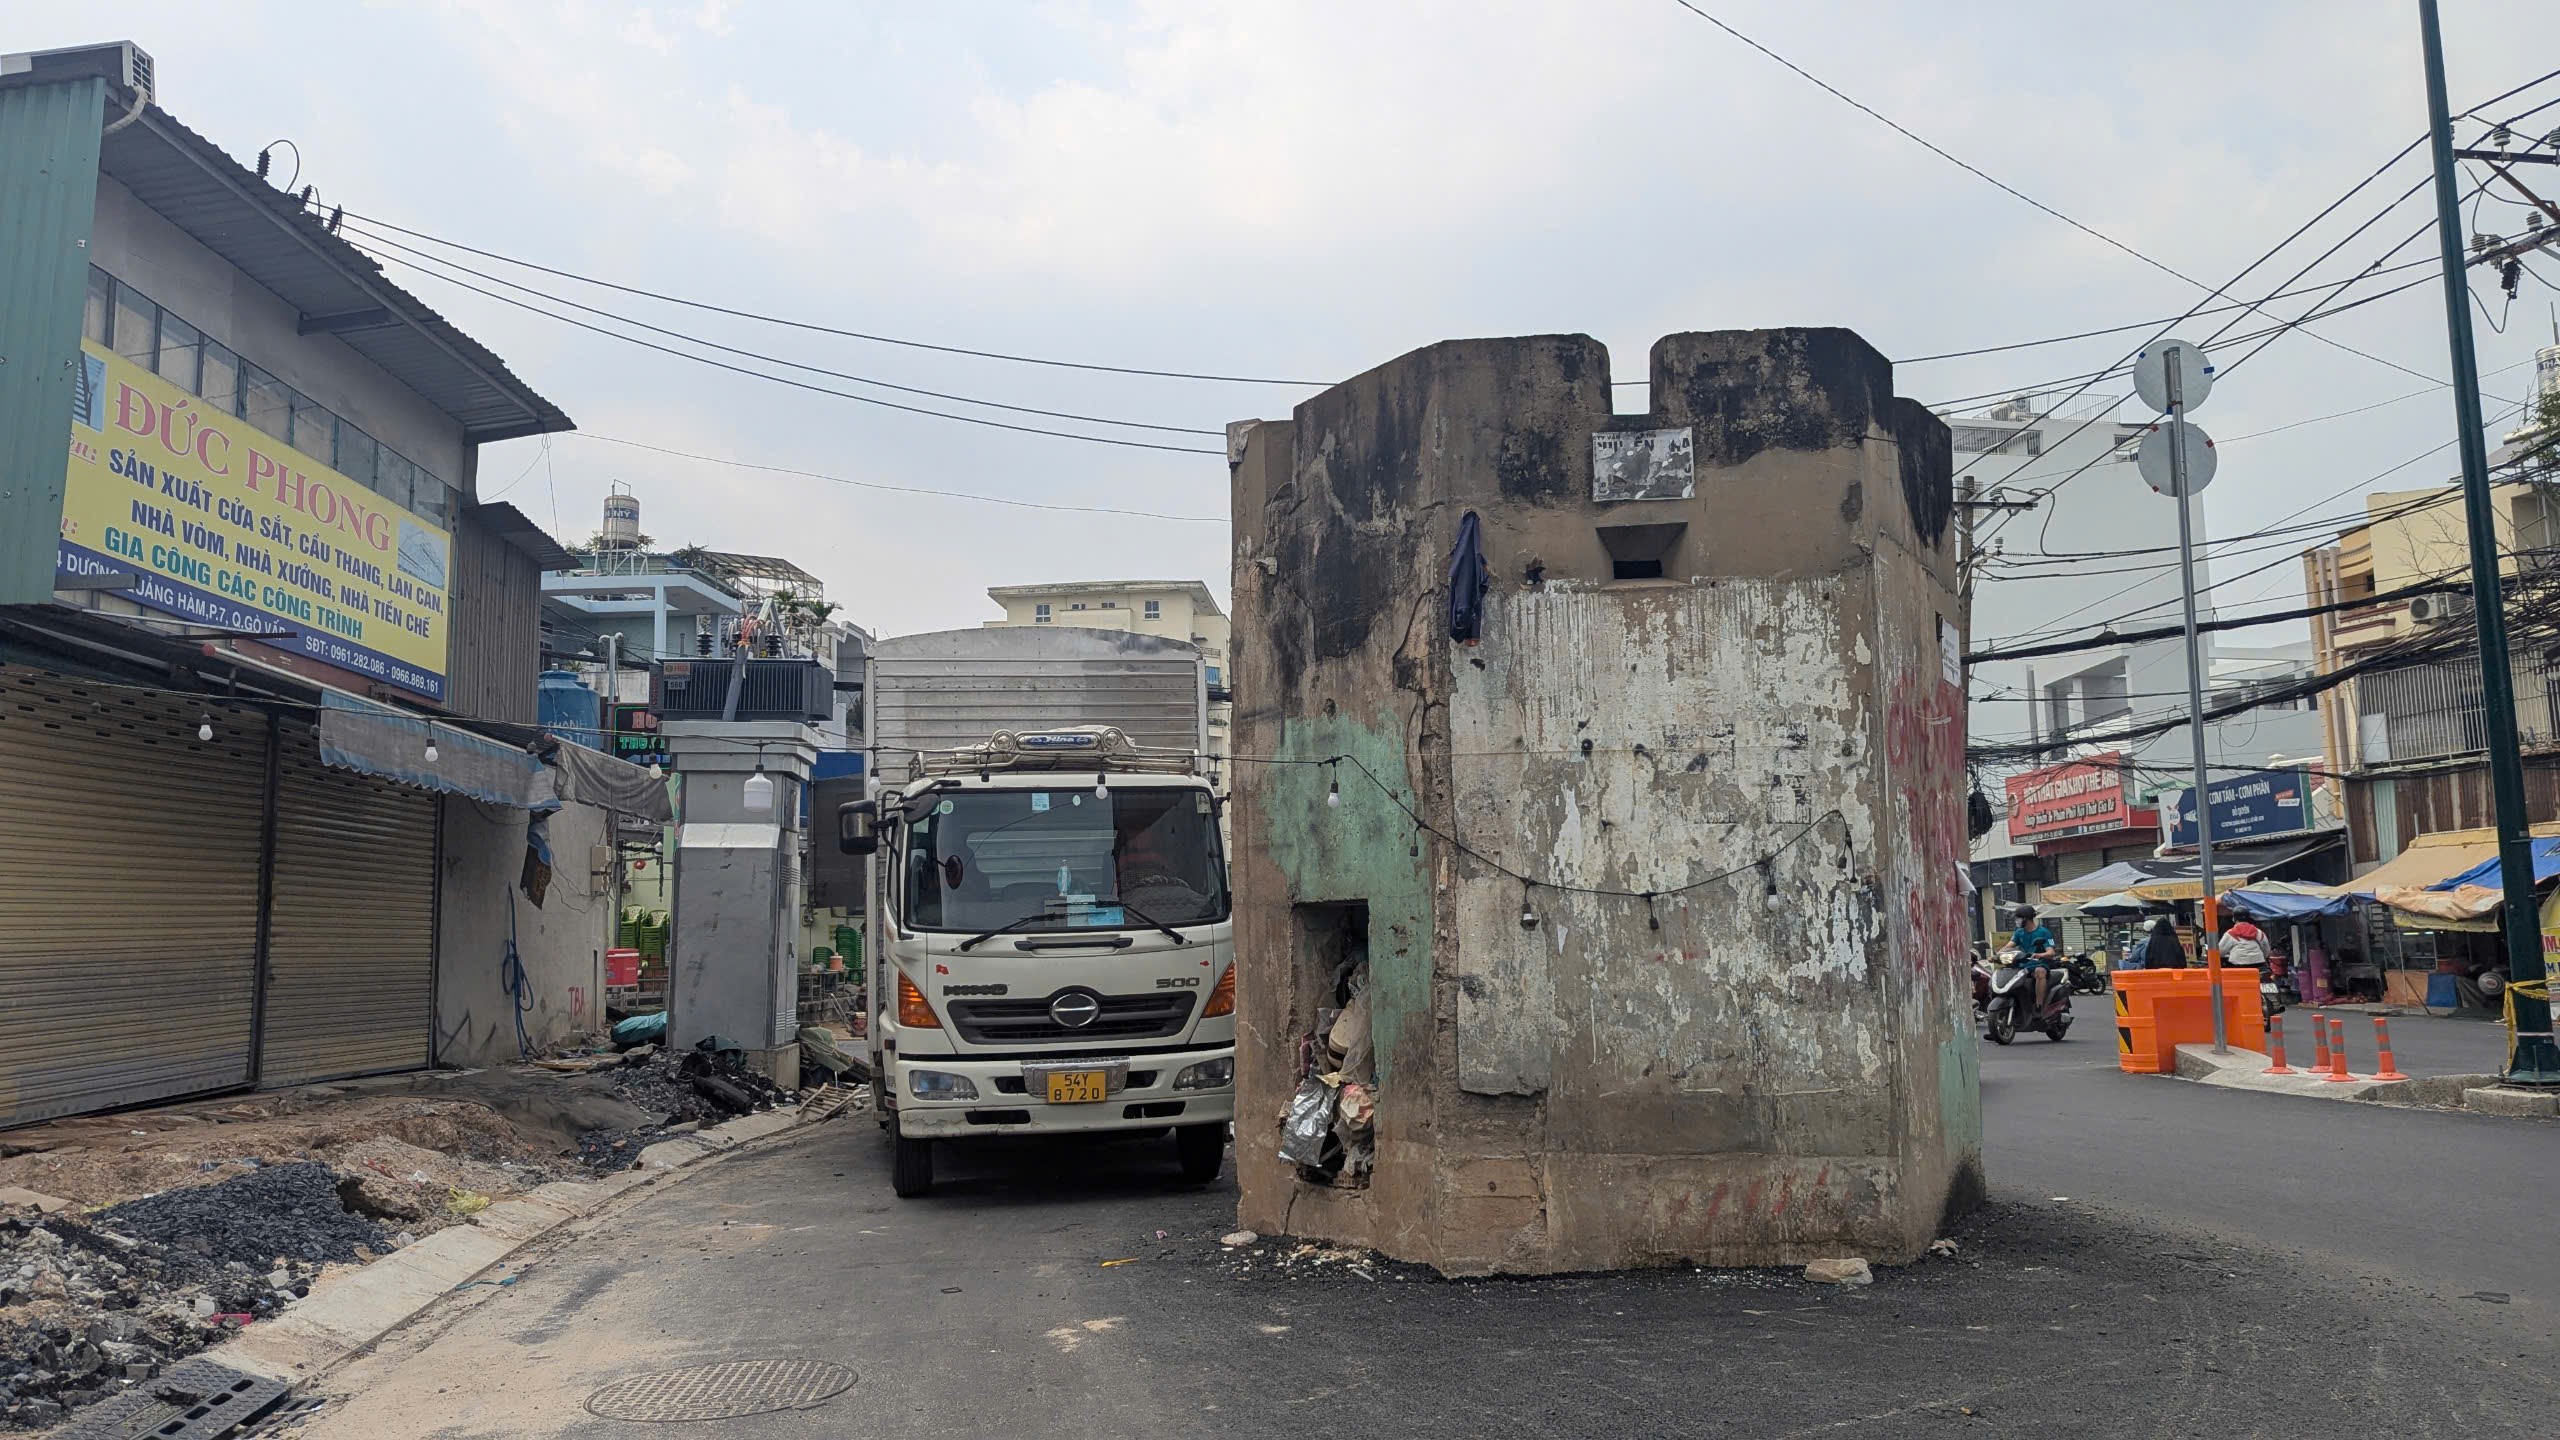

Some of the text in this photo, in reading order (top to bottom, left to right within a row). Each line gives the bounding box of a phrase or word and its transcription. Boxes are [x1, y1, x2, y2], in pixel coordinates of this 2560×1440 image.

[115, 382, 390, 550] ĐỨC PHONG
[109, 449, 444, 616] SẢN XUẤT CỬA SẮT, CẦU THANG, LAN CAN,
[132, 500, 175, 537] NHÀ
[182, 520, 229, 561] VÒM,
[235, 543, 272, 575] NHÀ
[277, 559, 335, 602] XƯỞNG,
[340, 585, 369, 614] NHÀ
[406, 613, 430, 638] CHẾ
[105, 527, 363, 640] GIA CÔNG CÁC CÔNG TRÌNH
[305, 635, 329, 651] SĐT:
[331, 645, 384, 675] 0961.282.086
[391, 666, 439, 694] 0966.869.161
[1156, 977, 1200, 988] 500
[1055, 1087, 1100, 1100] 8720
[1065, 1074, 1089, 1087] 54Y
